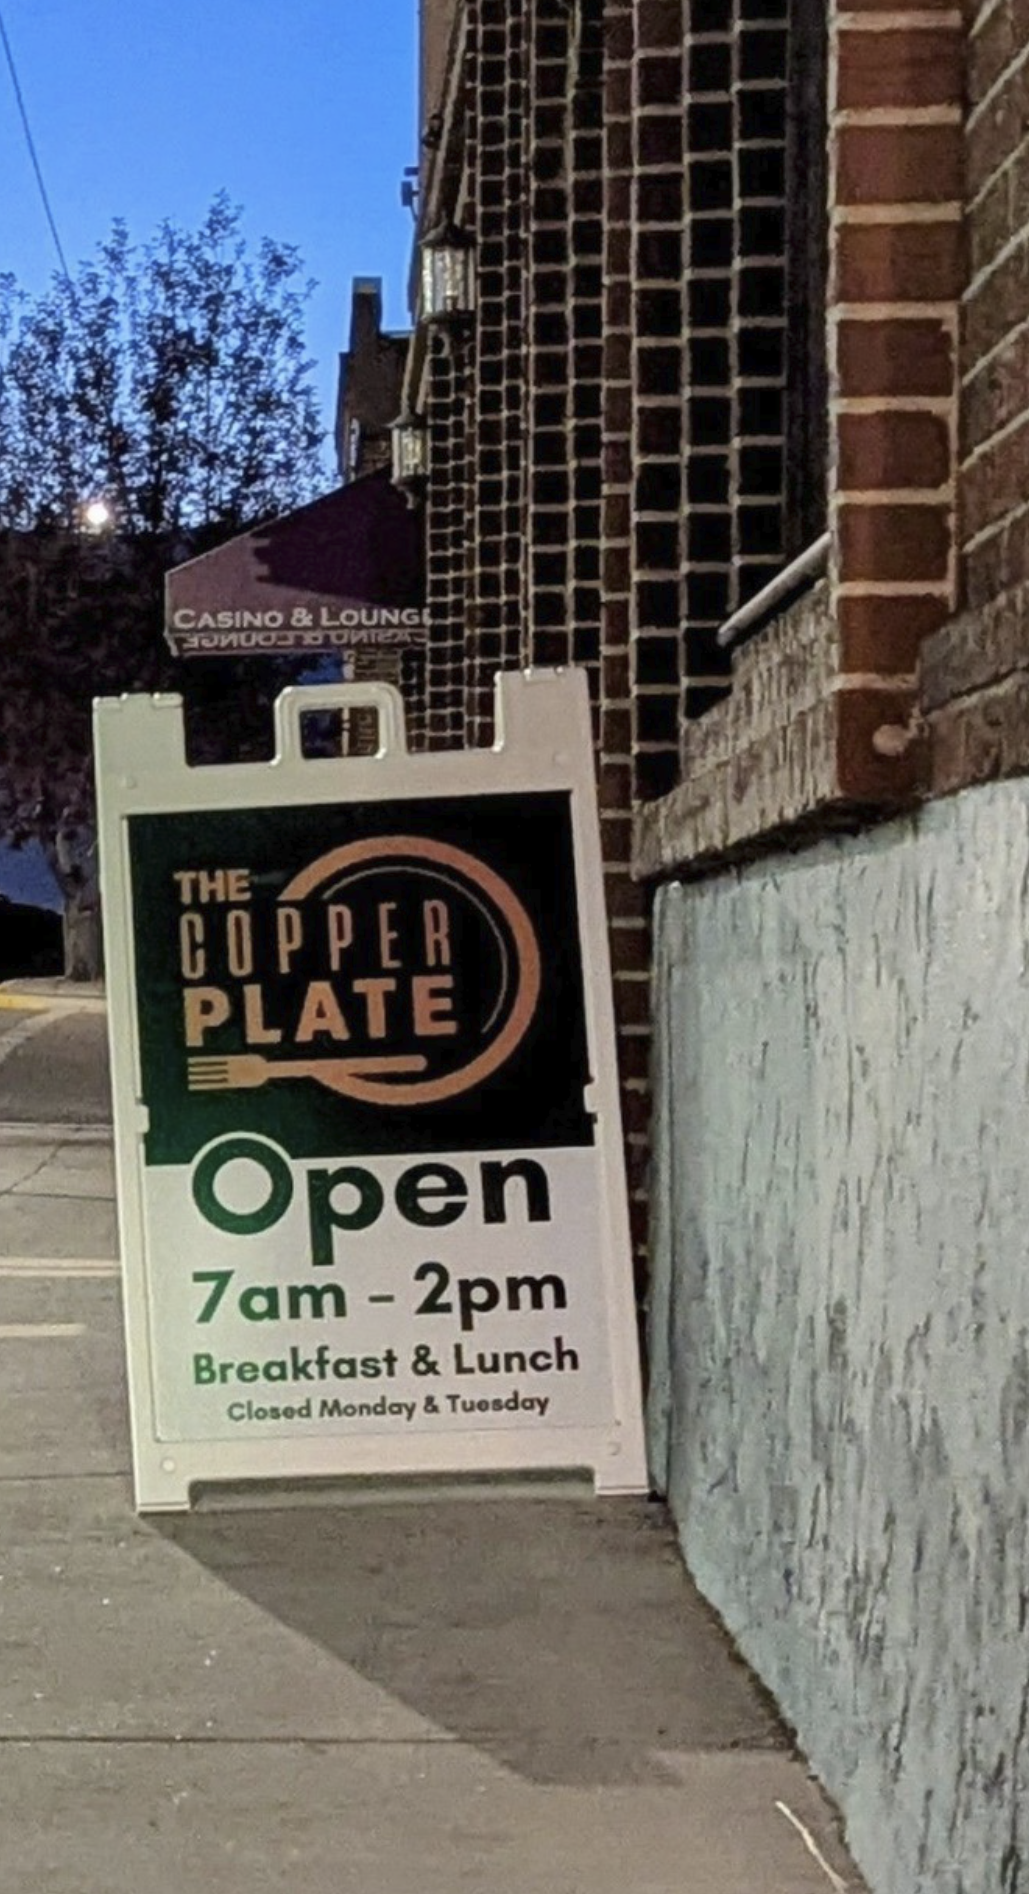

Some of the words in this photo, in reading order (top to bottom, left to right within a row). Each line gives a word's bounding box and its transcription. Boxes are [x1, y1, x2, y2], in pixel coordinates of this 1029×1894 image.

[173, 608, 283, 629] CASINO
[290, 607, 313, 627] &
[173, 869, 251, 904] THE
[179, 900, 451, 980] COPPER
[183, 974, 457, 1048] PLATE
[192, 1138, 551, 1266] Open
[191, 1269, 347, 1324] 7am
[413, 1261, 568, 1331] 2pm
[192, 1345, 399, 1385] Breakfast
[410, 1343, 441, 1377] &
[453, 1336, 580, 1376] Lunch
[227, 1396, 312, 1422] Closed
[318, 1394, 417, 1422] Monday
[423, 1394, 440, 1415] &
[445, 1390, 551, 1416] Tuesday
